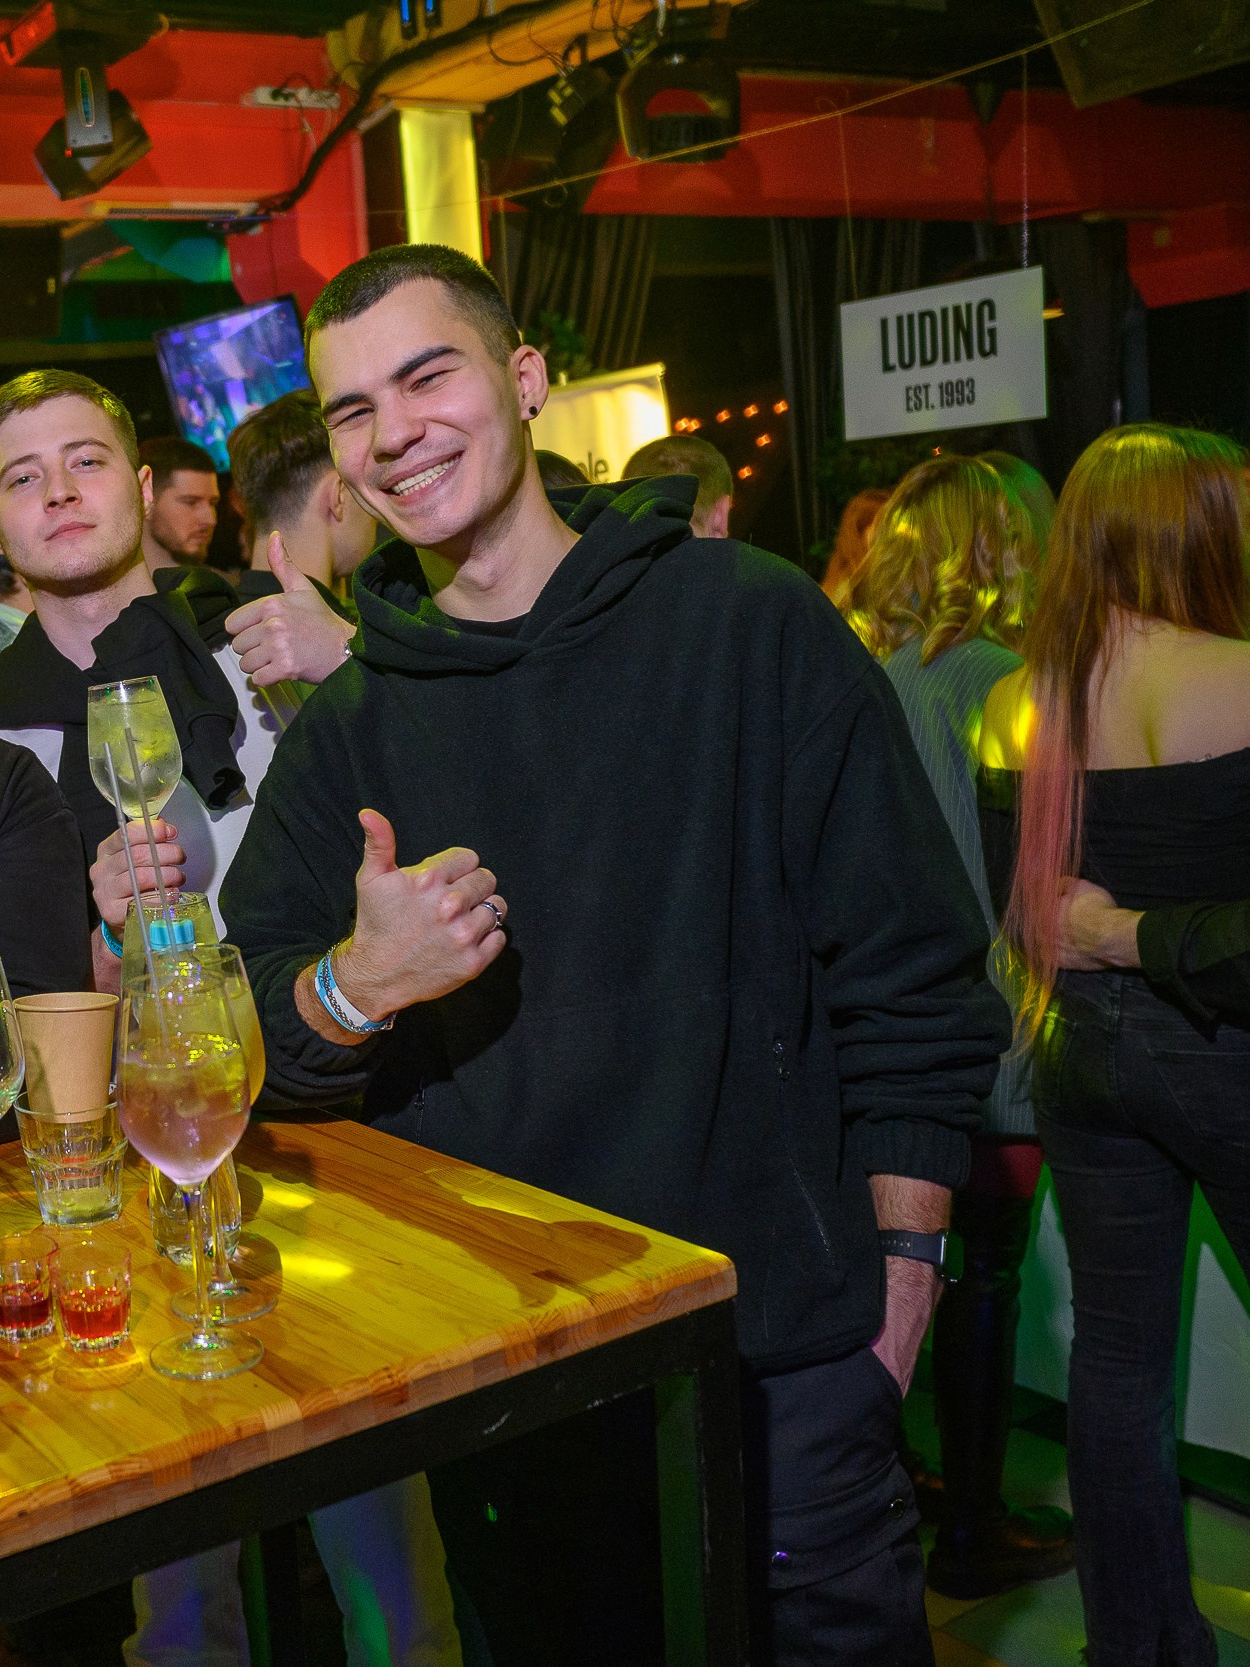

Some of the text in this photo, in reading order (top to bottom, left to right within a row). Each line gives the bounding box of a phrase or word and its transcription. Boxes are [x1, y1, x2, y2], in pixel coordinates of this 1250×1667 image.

[880, 298, 998, 374] LUDING
[905, 377, 976, 413] EST. 1993
